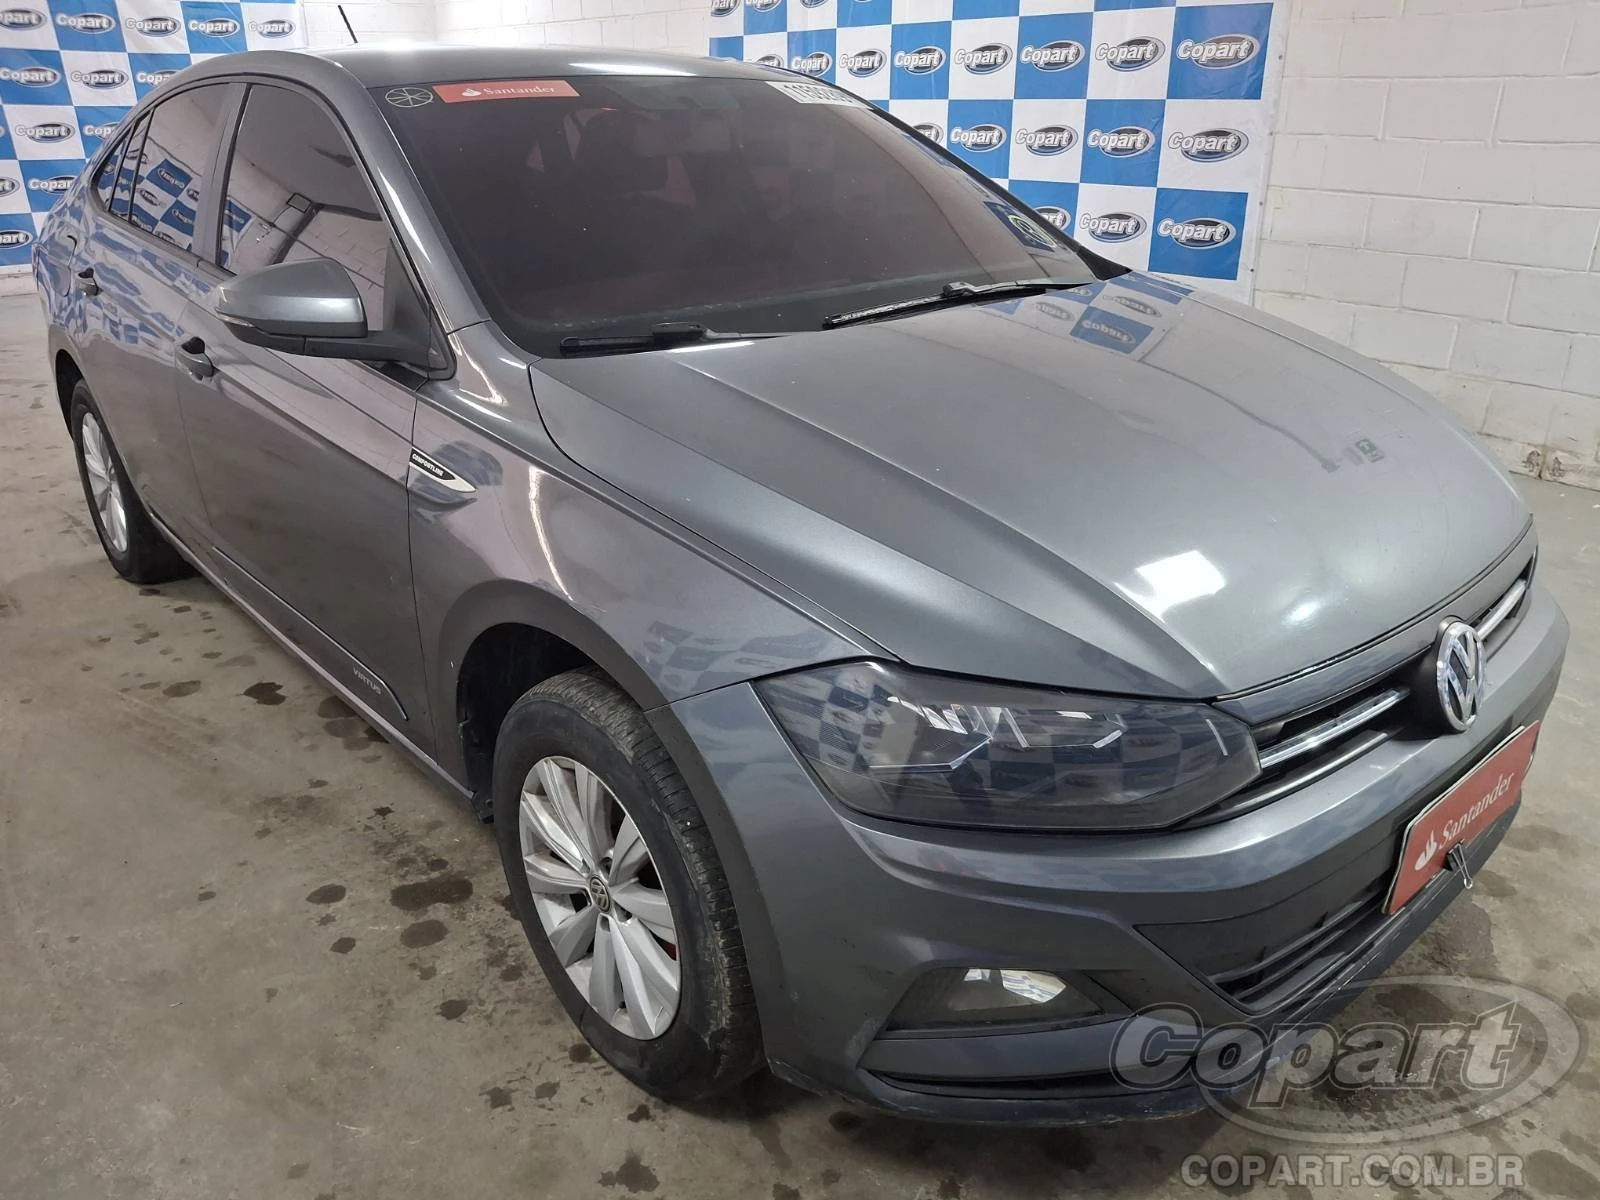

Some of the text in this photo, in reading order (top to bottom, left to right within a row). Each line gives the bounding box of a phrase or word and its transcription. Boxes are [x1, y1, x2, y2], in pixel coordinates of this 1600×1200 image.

[0, 12, 38, 26] opart
[56, 13, 109, 29] Copart
[126, 18, 175, 32] Copart
[188, 20, 235, 32] Copart
[249, 21, 291, 33] Copart
[955, 47, 1004, 67] Copart
[1021, 45, 1080, 65] Copart
[1095, 43, 1154, 64] Copart
[1177, 38, 1250, 62] Copart
[791, 55, 827, 72] Copart
[839, 53, 880, 71] Copart
[894, 50, 942, 70] Copart
[0, 68, 54, 83] Copart
[71, 71, 121, 84] Copart
[483, 85, 556, 95] Santander
[15, 124, 69, 139] Copart
[950, 127, 1000, 145] Copart
[1015, 128, 1074, 149] Copart
[1087, 129, 1148, 151] Copart
[1168, 131, 1238, 154] Copart
[1079, 211, 1140, 235] Copart
[1157, 218, 1228, 243] Copart
[1438, 771, 1514, 849] Santander
